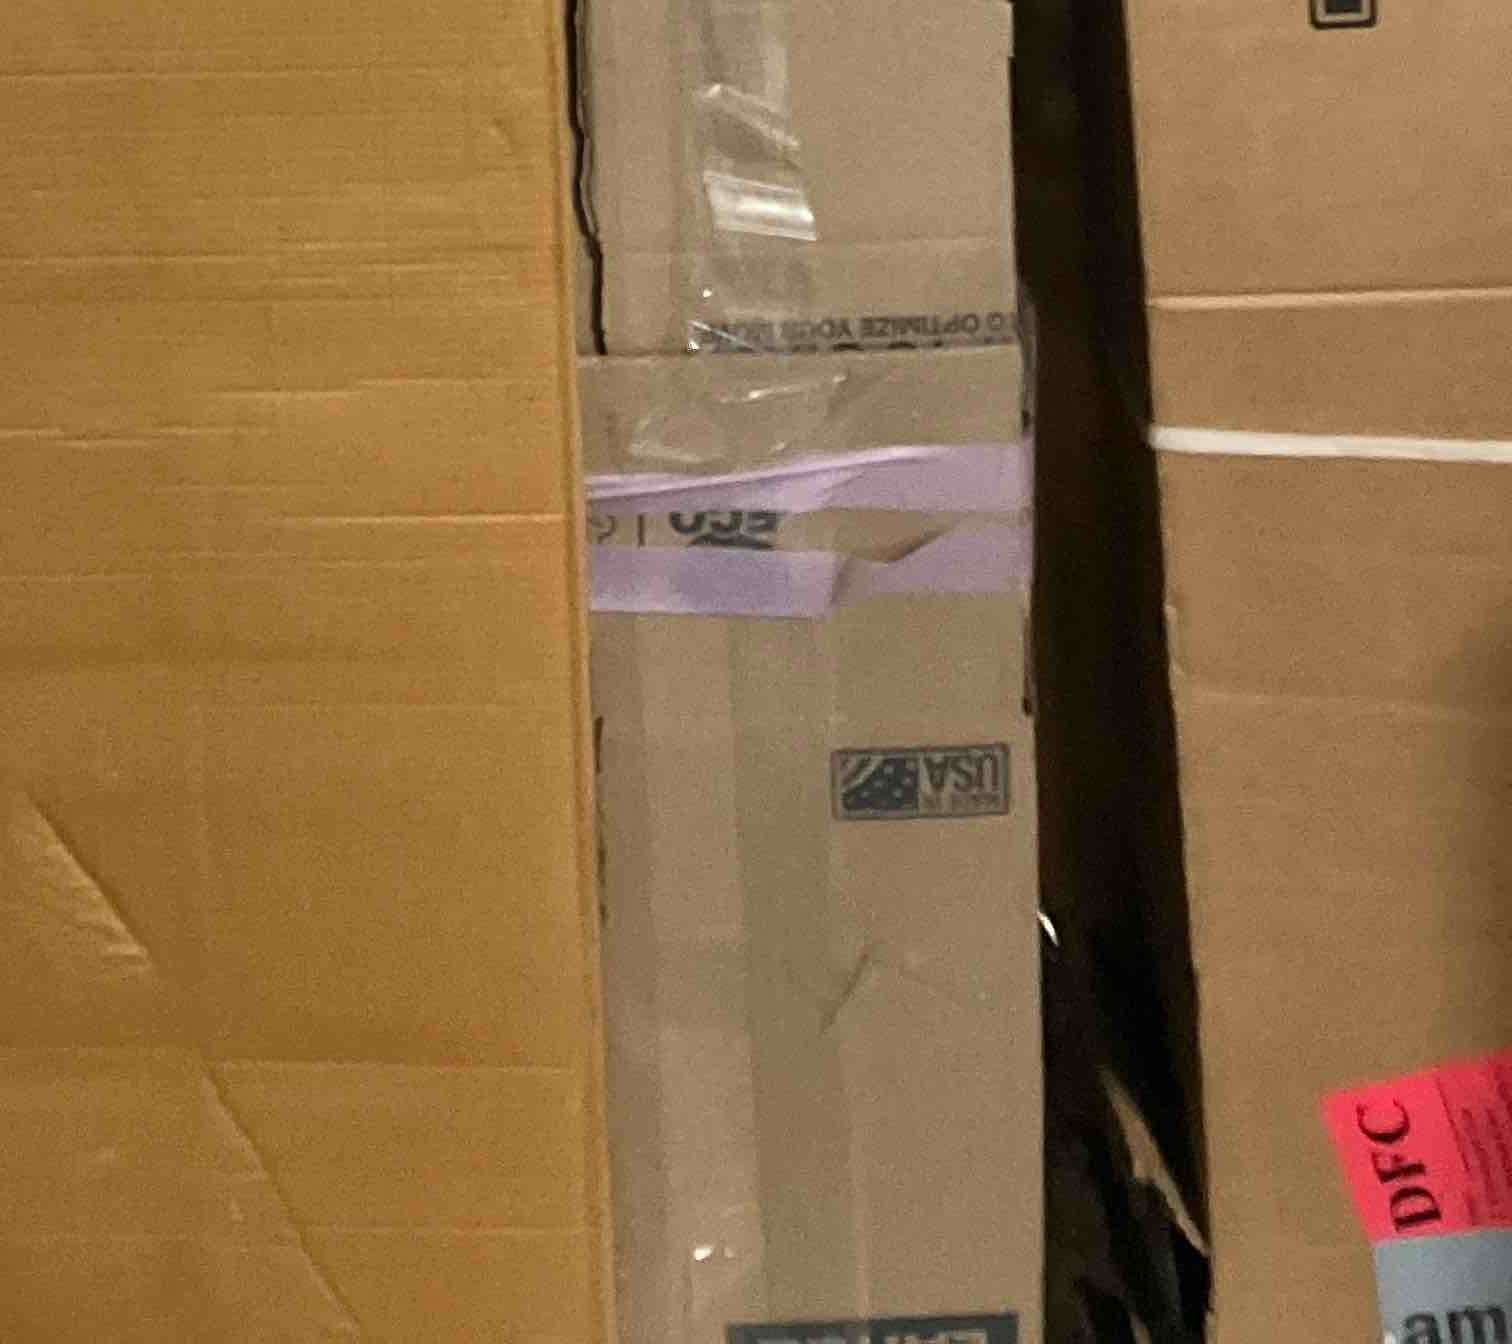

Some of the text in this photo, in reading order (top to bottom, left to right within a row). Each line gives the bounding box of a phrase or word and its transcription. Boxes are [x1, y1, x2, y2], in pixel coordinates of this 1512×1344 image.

[860, 313, 979, 338] OPTIMIZE
[922, 752, 999, 792] USA
[1354, 1097, 1443, 1234] DFC
